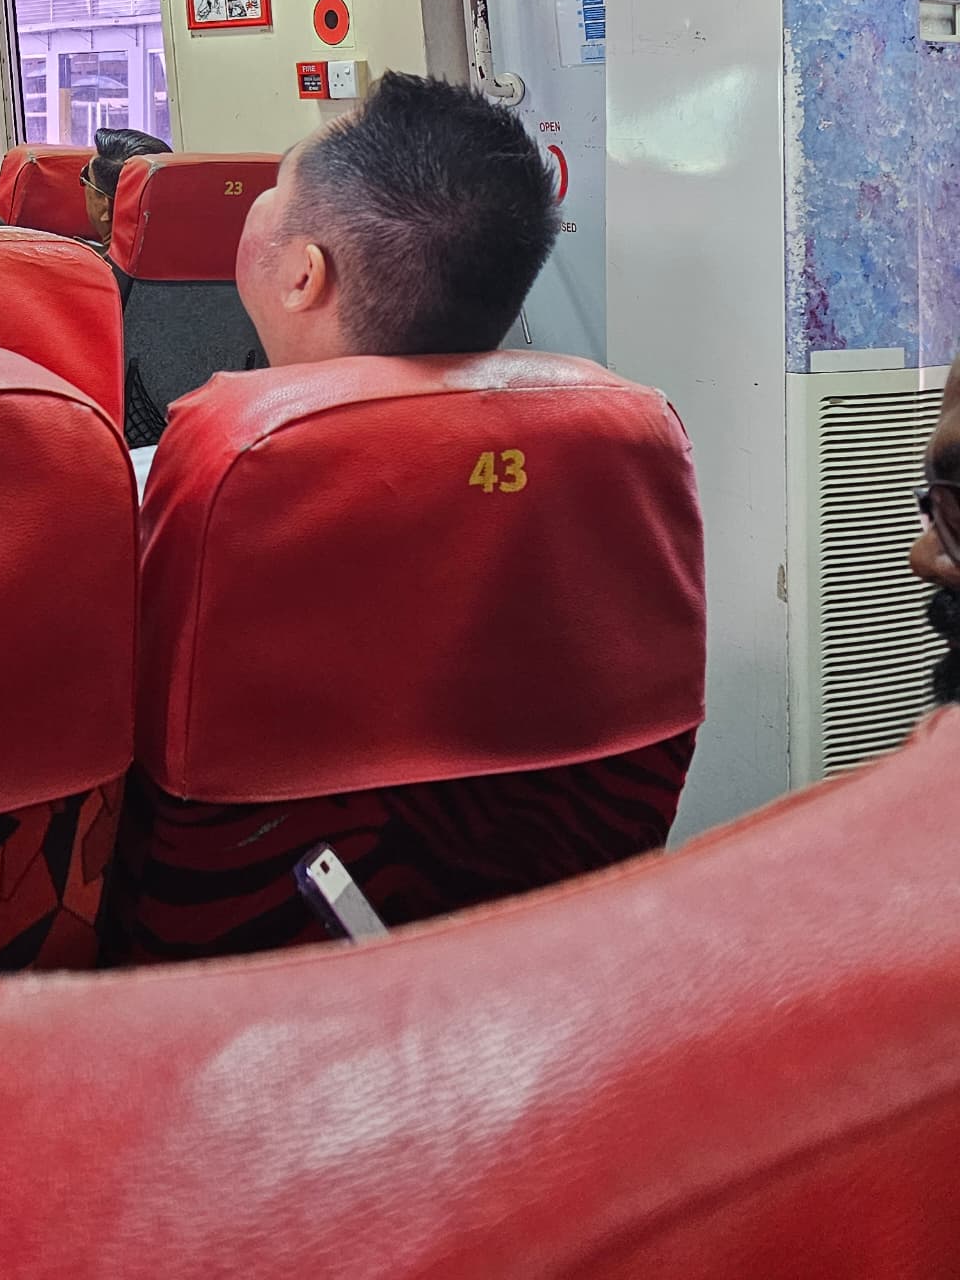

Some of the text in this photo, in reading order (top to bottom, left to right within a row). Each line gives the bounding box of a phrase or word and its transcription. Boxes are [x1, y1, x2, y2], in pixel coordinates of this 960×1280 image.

[302, 65, 316, 73] FIRE
[540, 121, 560, 132] OPEN
[224, 181, 243, 195] 23
[468, 448, 528, 493] 43
